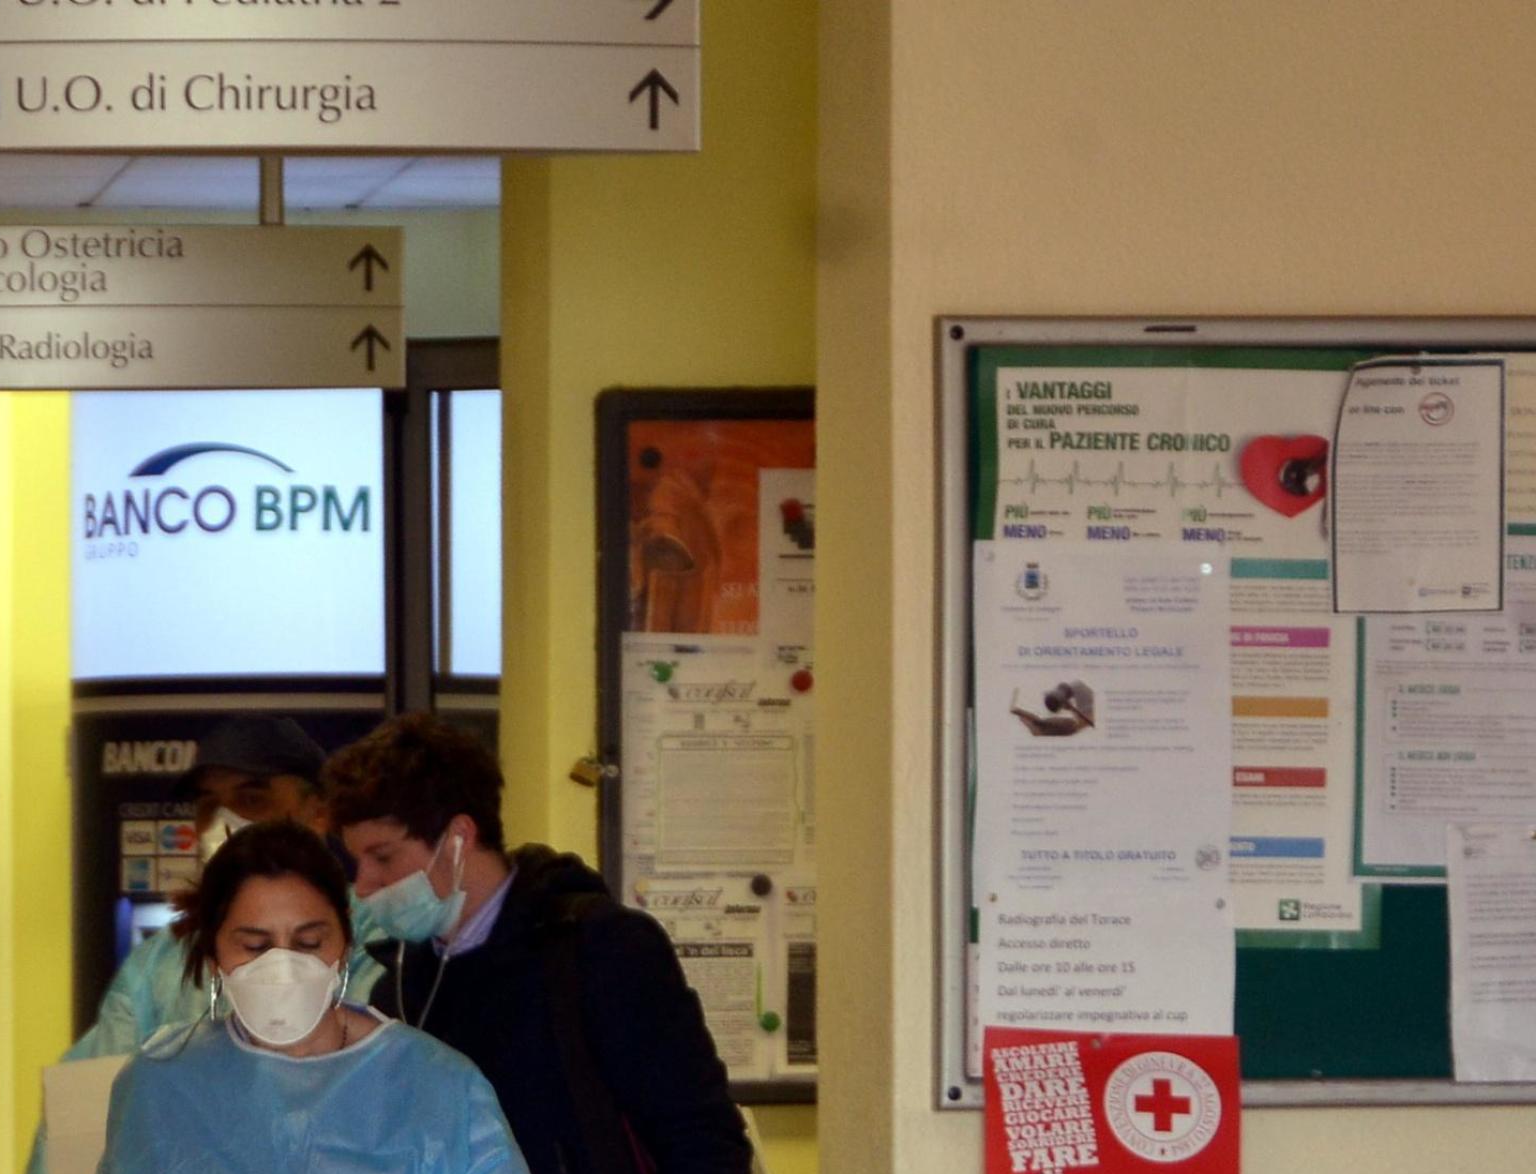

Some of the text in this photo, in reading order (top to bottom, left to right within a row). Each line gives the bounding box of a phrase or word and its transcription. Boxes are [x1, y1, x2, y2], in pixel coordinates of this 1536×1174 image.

[16, 74, 377, 124] U.O. di Chirurgia
[21, 229, 185, 260] Ostetricia
[1017, 381, 1112, 400] VANTAGGI
[1007, 404, 1139, 416] DEL NUOVO PERCORSO
[1023, 418, 1056, 430] CURA
[1008, 437, 1031, 450] PER
[1049, 432, 1139, 451] PAZIENTE
[84, 484, 371, 539] BANCO BPM
[1004, 525, 1047, 540] MENO
[1087, 525, 1130, 541] MENO
[1182, 527, 1226, 543] MENO
[1064, 627, 1138, 640] SPORTELLO
[1034, 646, 1131, 658] ORIENTAMENTO
[1135, 646, 1184, 658] LEGALE
[1021, 850, 1059, 861] TUTTO
[1074, 850, 1114, 861] TITOLO
[1117, 850, 1177, 862] GRATUITO
[998, 913, 1066, 927] Radiografia
[1092, 914, 1131, 926] Torace
[998, 937, 1091, 950] Accesso diretto
[998, 961, 1136, 974] Dalle ore 10 alle ore 15
[997, 985, 1016, 997] Dal
[997, 1009, 1074, 1023] regolarizzare
[994, 1052, 1082, 1072] AMARE
[999, 1077, 1089, 1101] DARE
[1002, 1094, 1092, 1113] RICEVERE
[1005, 1107, 1093, 1126] GIOCARE
[1005, 1119, 1096, 1140] VOLARE
[1010, 1144, 1100, 1173] FARE
